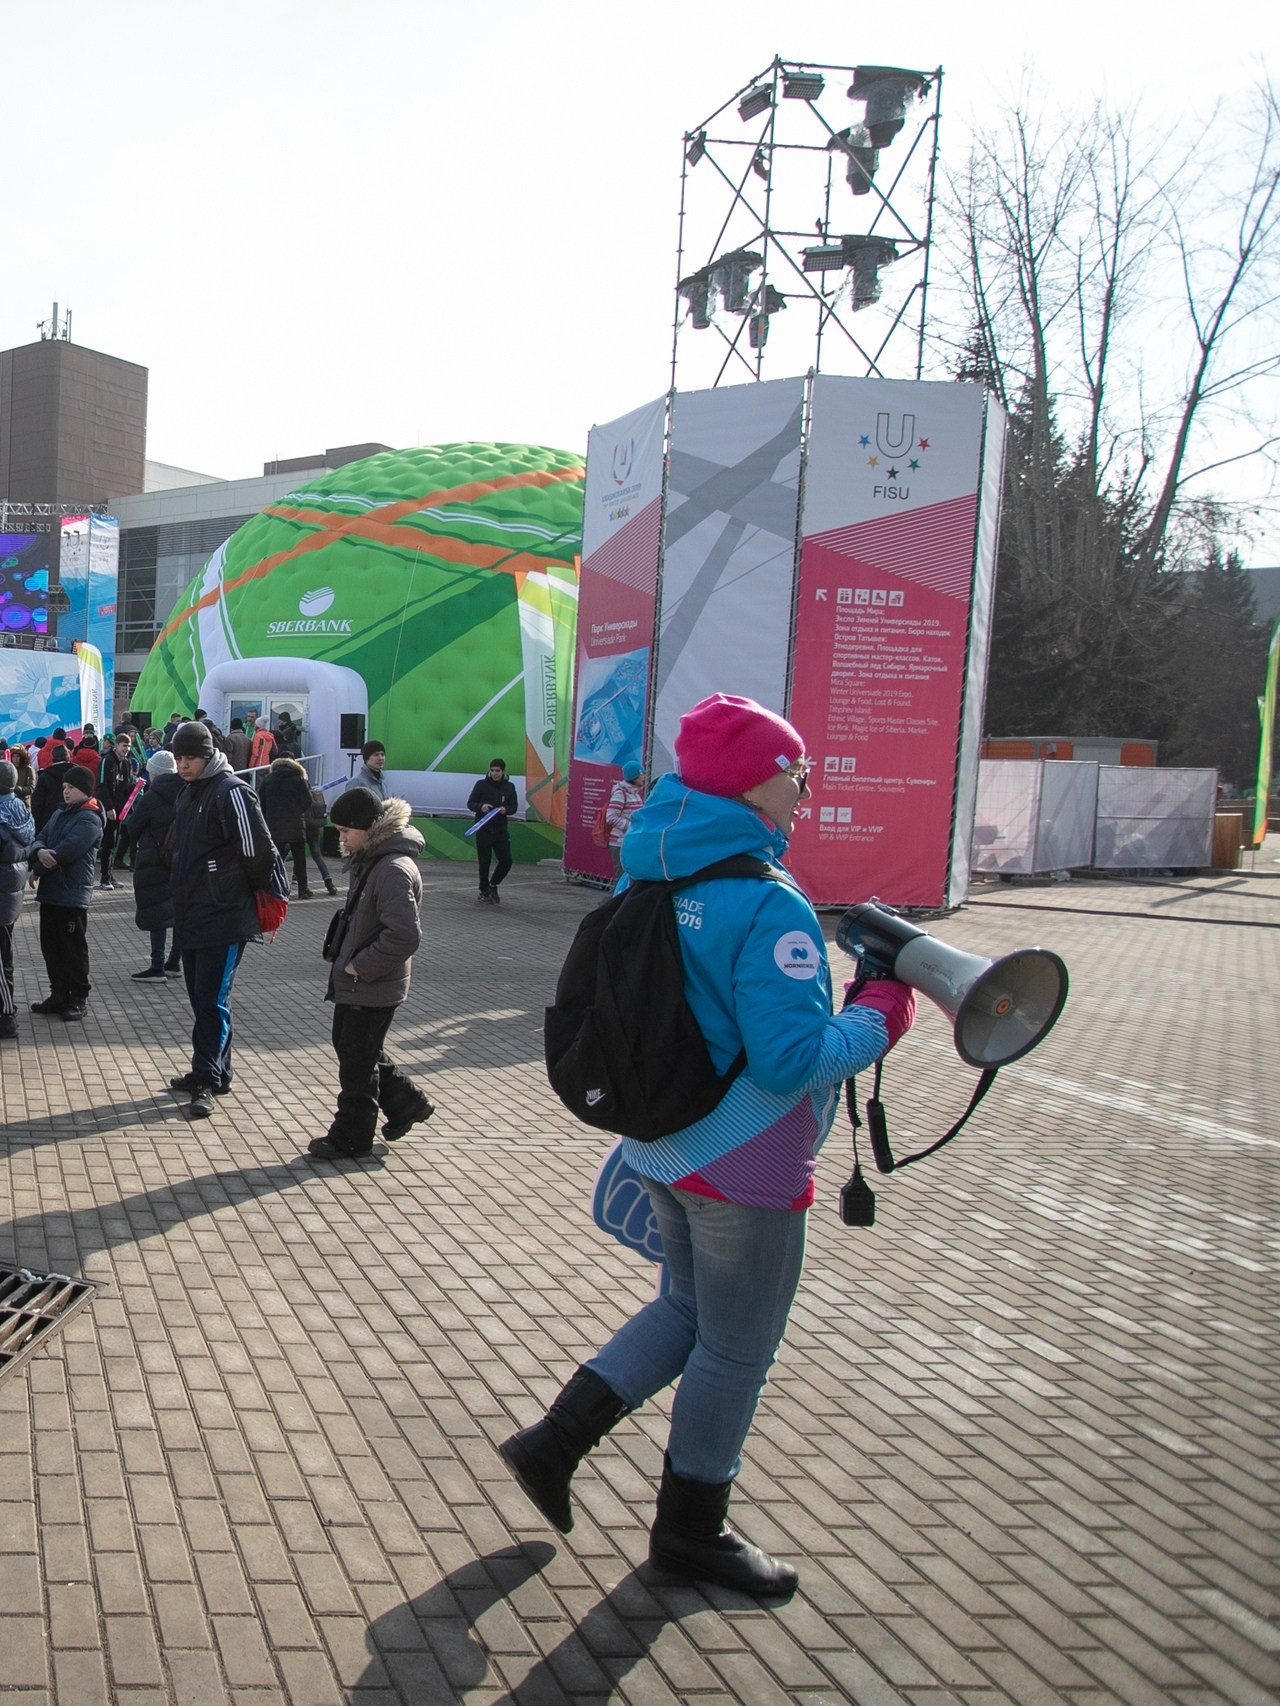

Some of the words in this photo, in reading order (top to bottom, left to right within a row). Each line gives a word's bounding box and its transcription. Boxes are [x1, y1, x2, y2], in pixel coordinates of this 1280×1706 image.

[872, 485, 910, 501] FISU
[267, 619, 354, 634] SBERBANK
[591, 624, 604, 635] Парк
[604, 619, 639, 633] Универсиады
[835, 615, 855, 623] Экспо
[856, 616, 879, 624] Зимней
[880, 617, 922, 626] Универсиады
[923, 619, 942, 627] 2019.
[586, 1088, 601, 1099] NIKE
